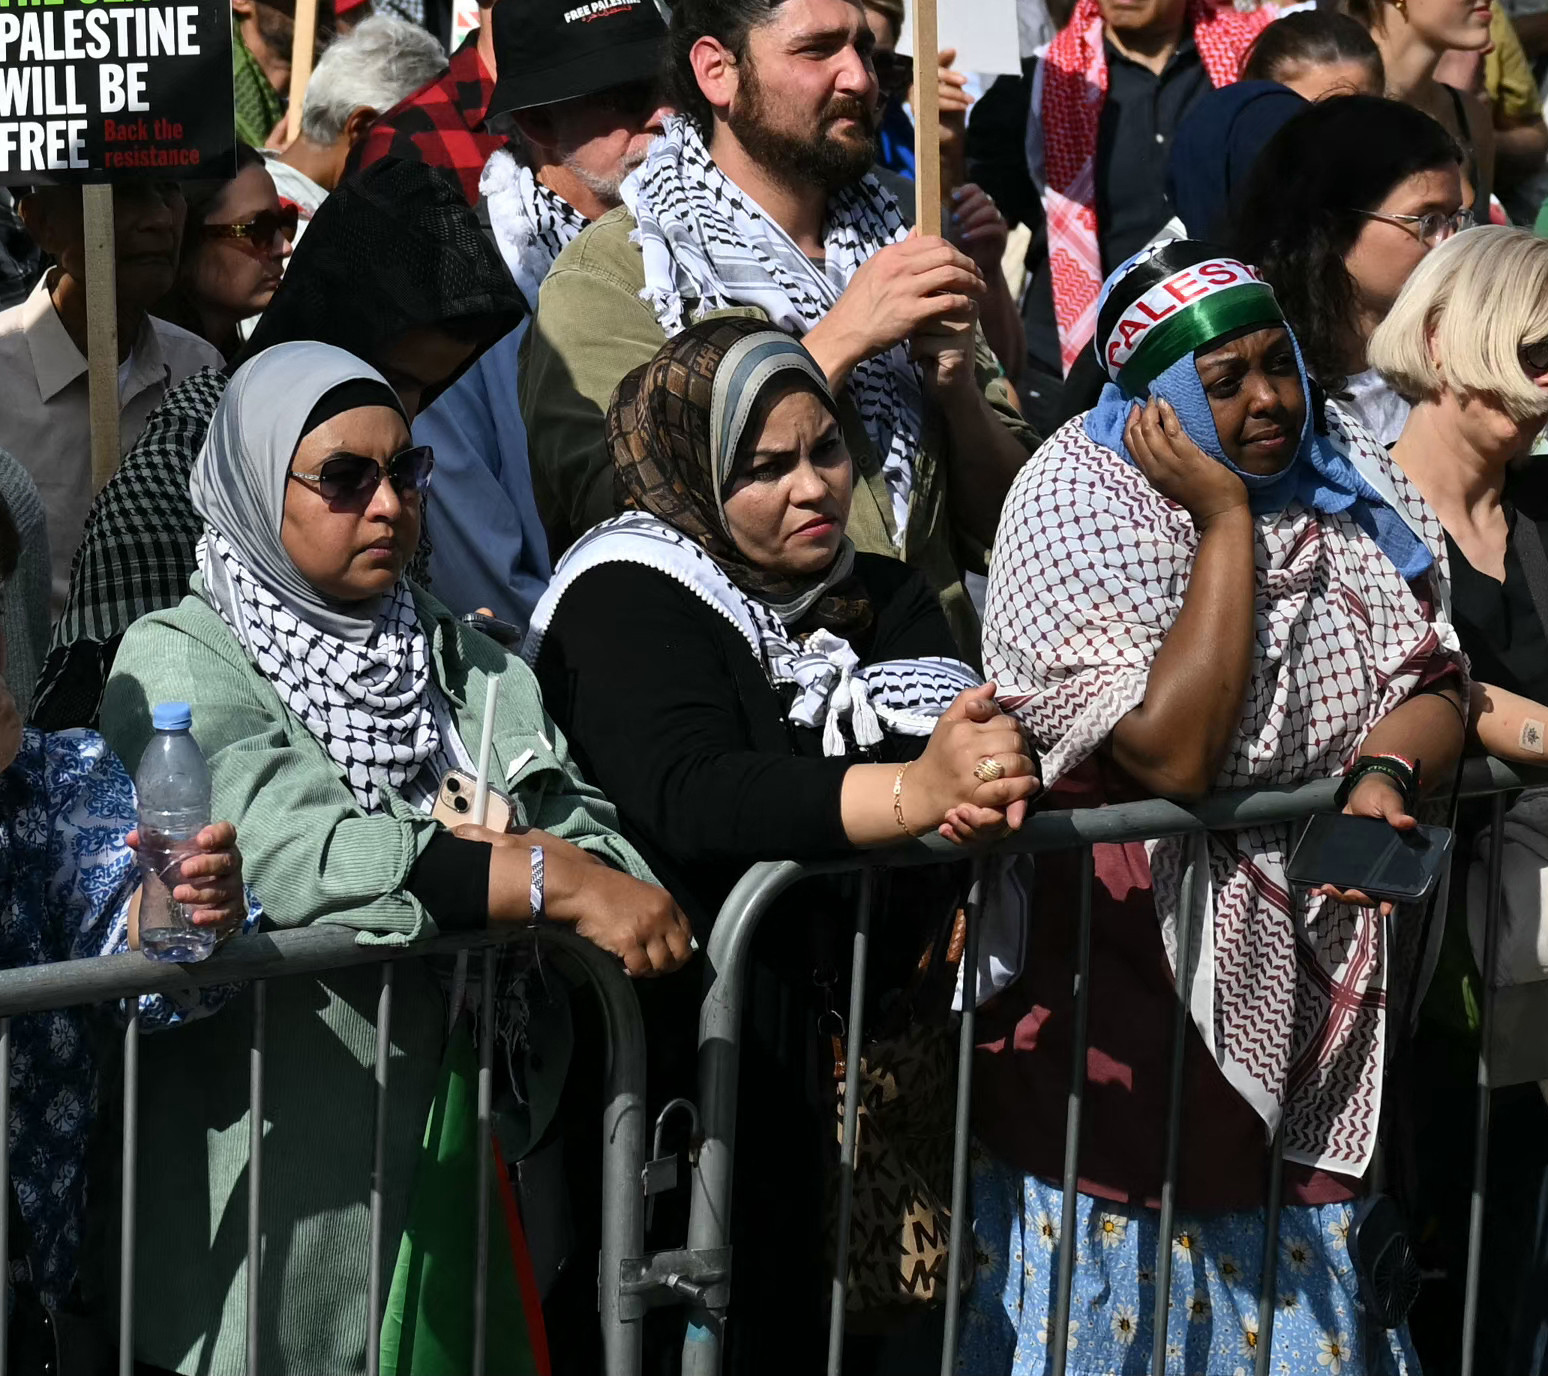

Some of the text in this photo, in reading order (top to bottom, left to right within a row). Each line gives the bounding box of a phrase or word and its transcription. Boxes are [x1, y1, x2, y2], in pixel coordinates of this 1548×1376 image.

[564, 3, 592, 24] FREE
[98, 62, 150, 114] BE
[103, 117, 184, 143] Back the
[103, 143, 201, 169] resistance
